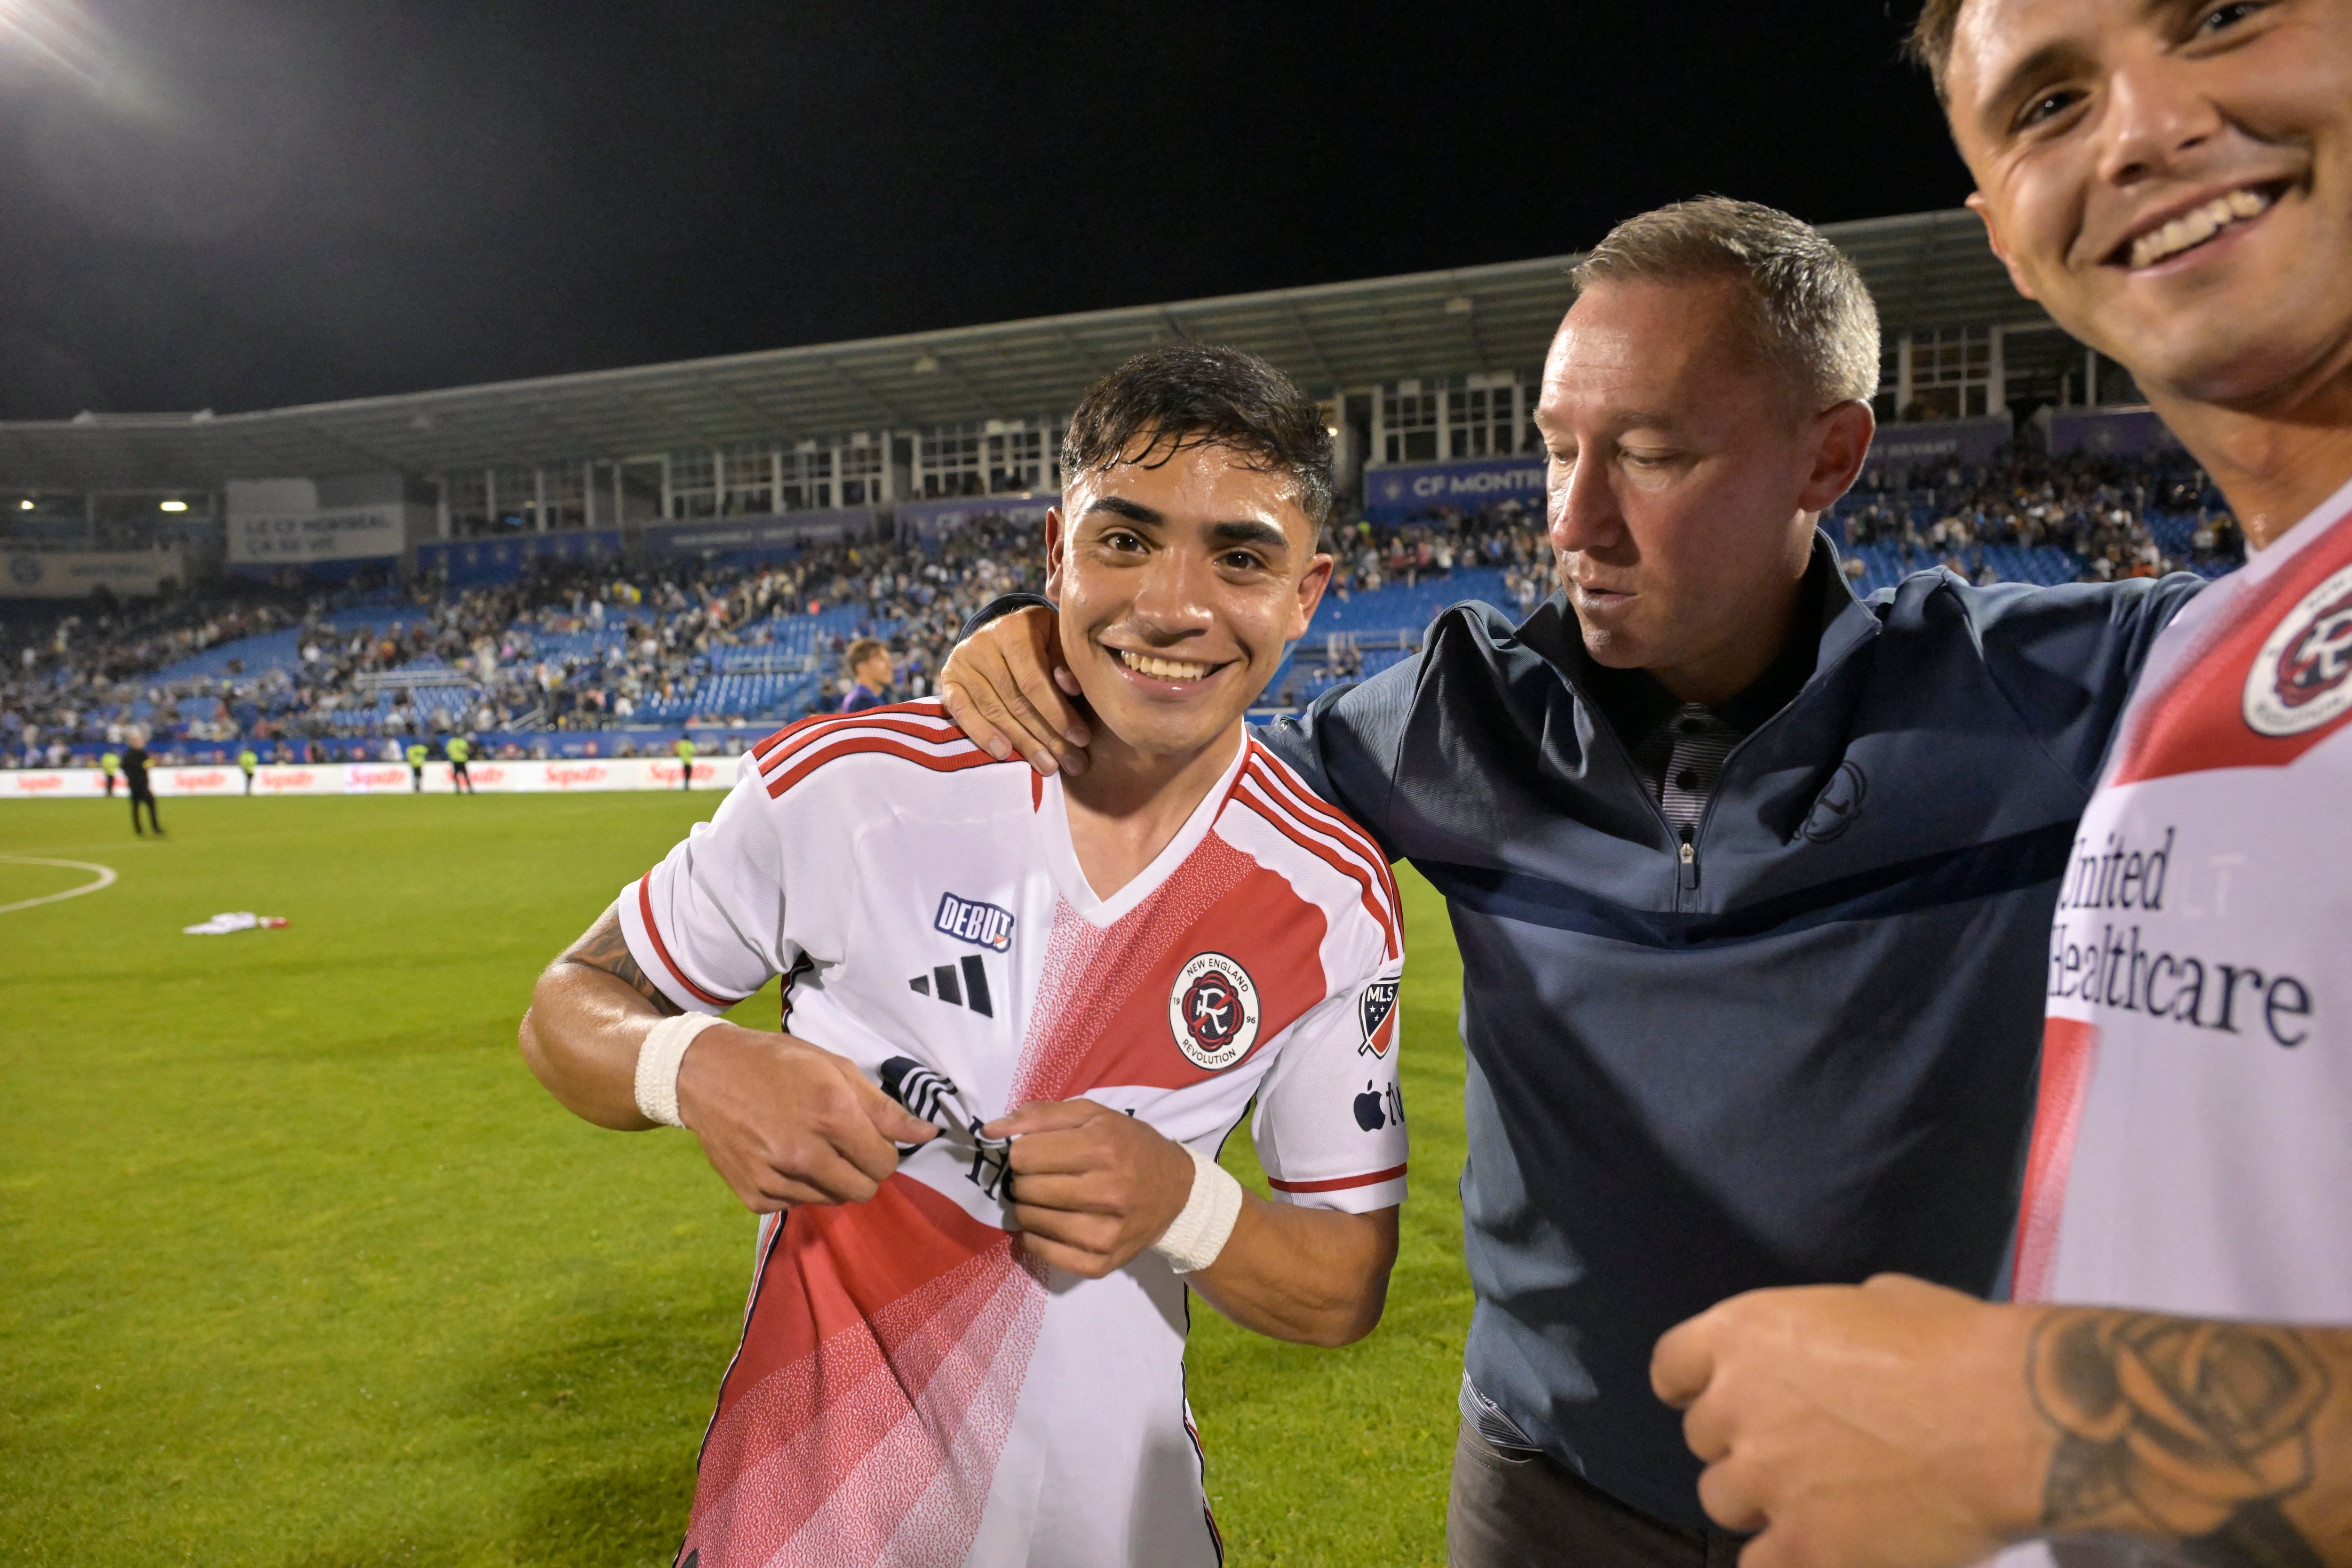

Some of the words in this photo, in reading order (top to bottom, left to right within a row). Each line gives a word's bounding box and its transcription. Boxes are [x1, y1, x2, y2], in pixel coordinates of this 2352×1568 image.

[1413, 474, 1446, 497] CF
[1451, 470, 1546, 493] MONTR
[938, 896, 1011, 944] DEBUT
[1187, 959, 1205, 977] NEW
[1208, 958, 1249, 992] ENGLAND
[1367, 986, 1394, 1003] MLS
[1246, 1016, 1255, 1024] 96
[1182, 1039, 1236, 1064] REVOLUTION
